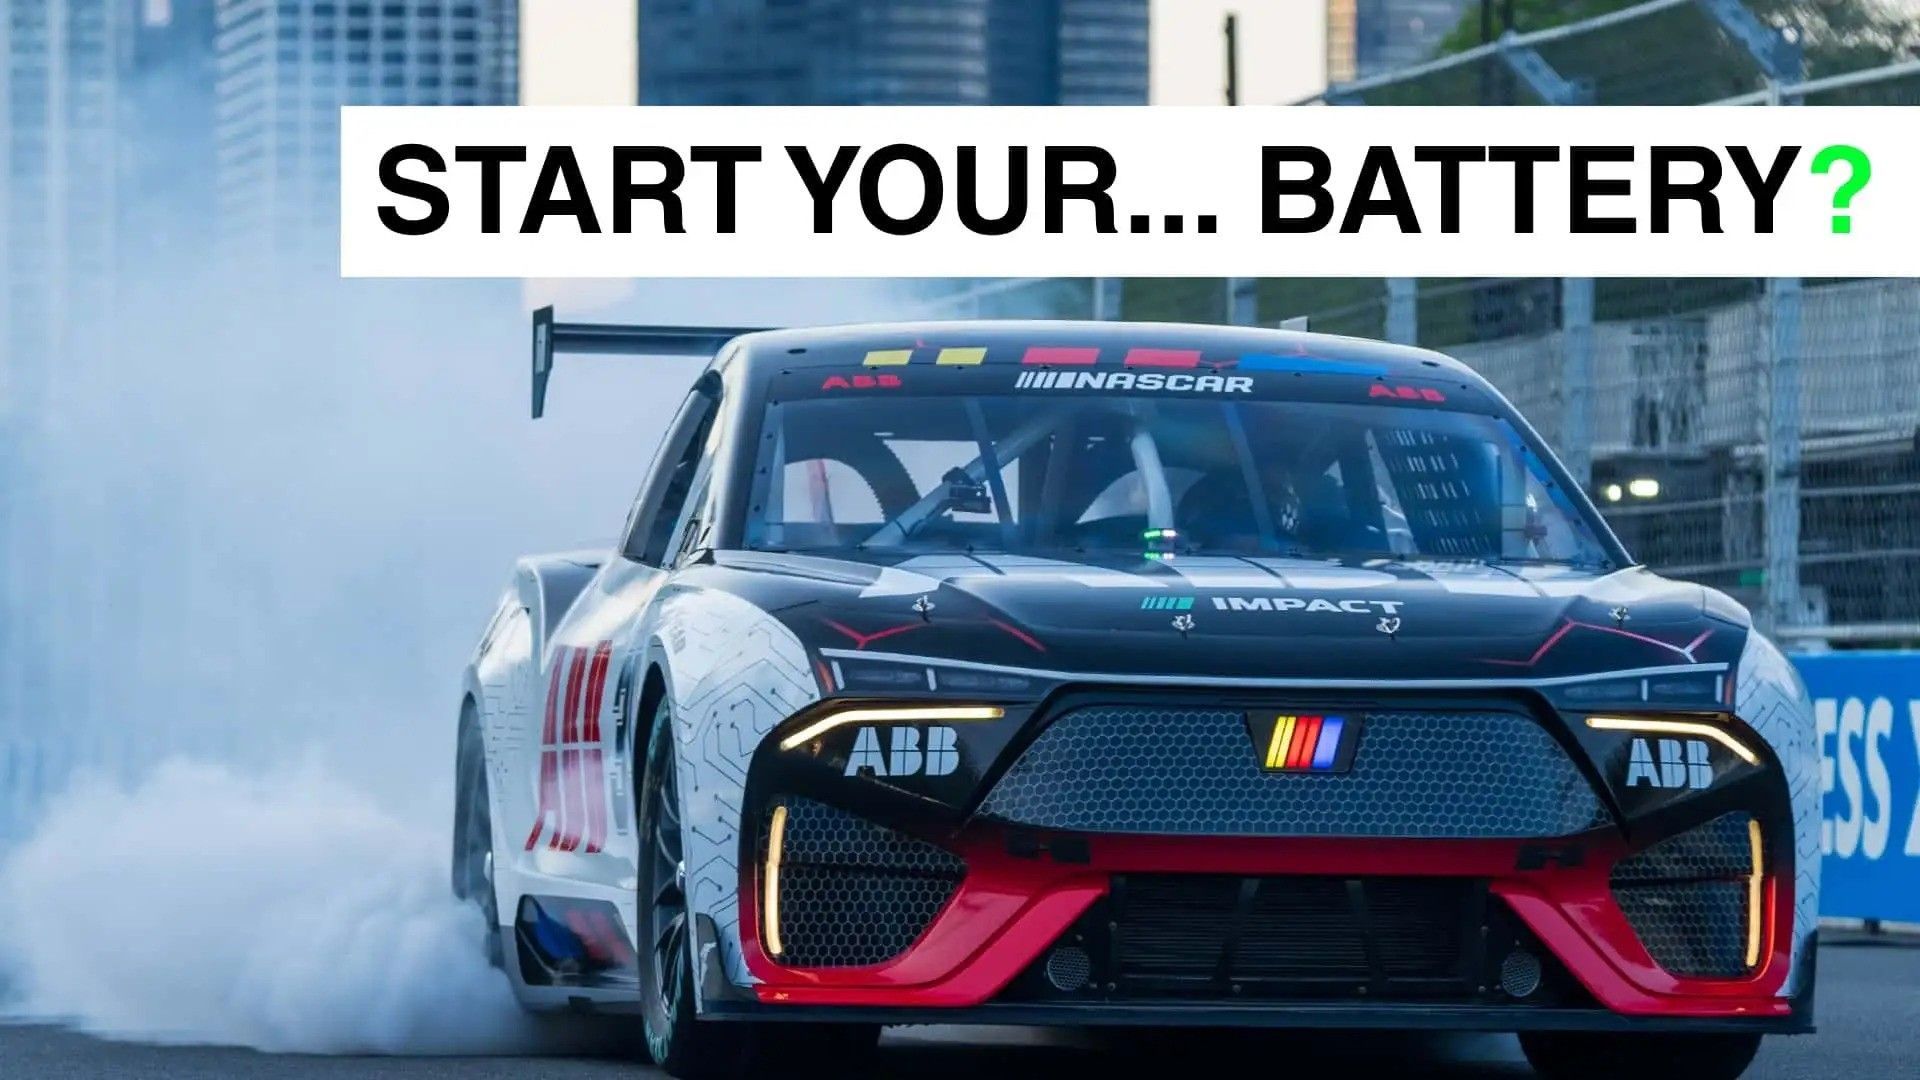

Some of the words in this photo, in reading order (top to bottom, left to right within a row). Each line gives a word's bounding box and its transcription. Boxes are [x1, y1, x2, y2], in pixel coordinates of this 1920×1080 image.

[823, 374, 901, 390] ABB
[1074, 371, 1254, 393] NASCAR
[1369, 383, 1445, 402] ABB
[1212, 597, 1404, 614] IMPACT
[844, 726, 959, 777] ABB
[1626, 738, 1713, 789] ABB
